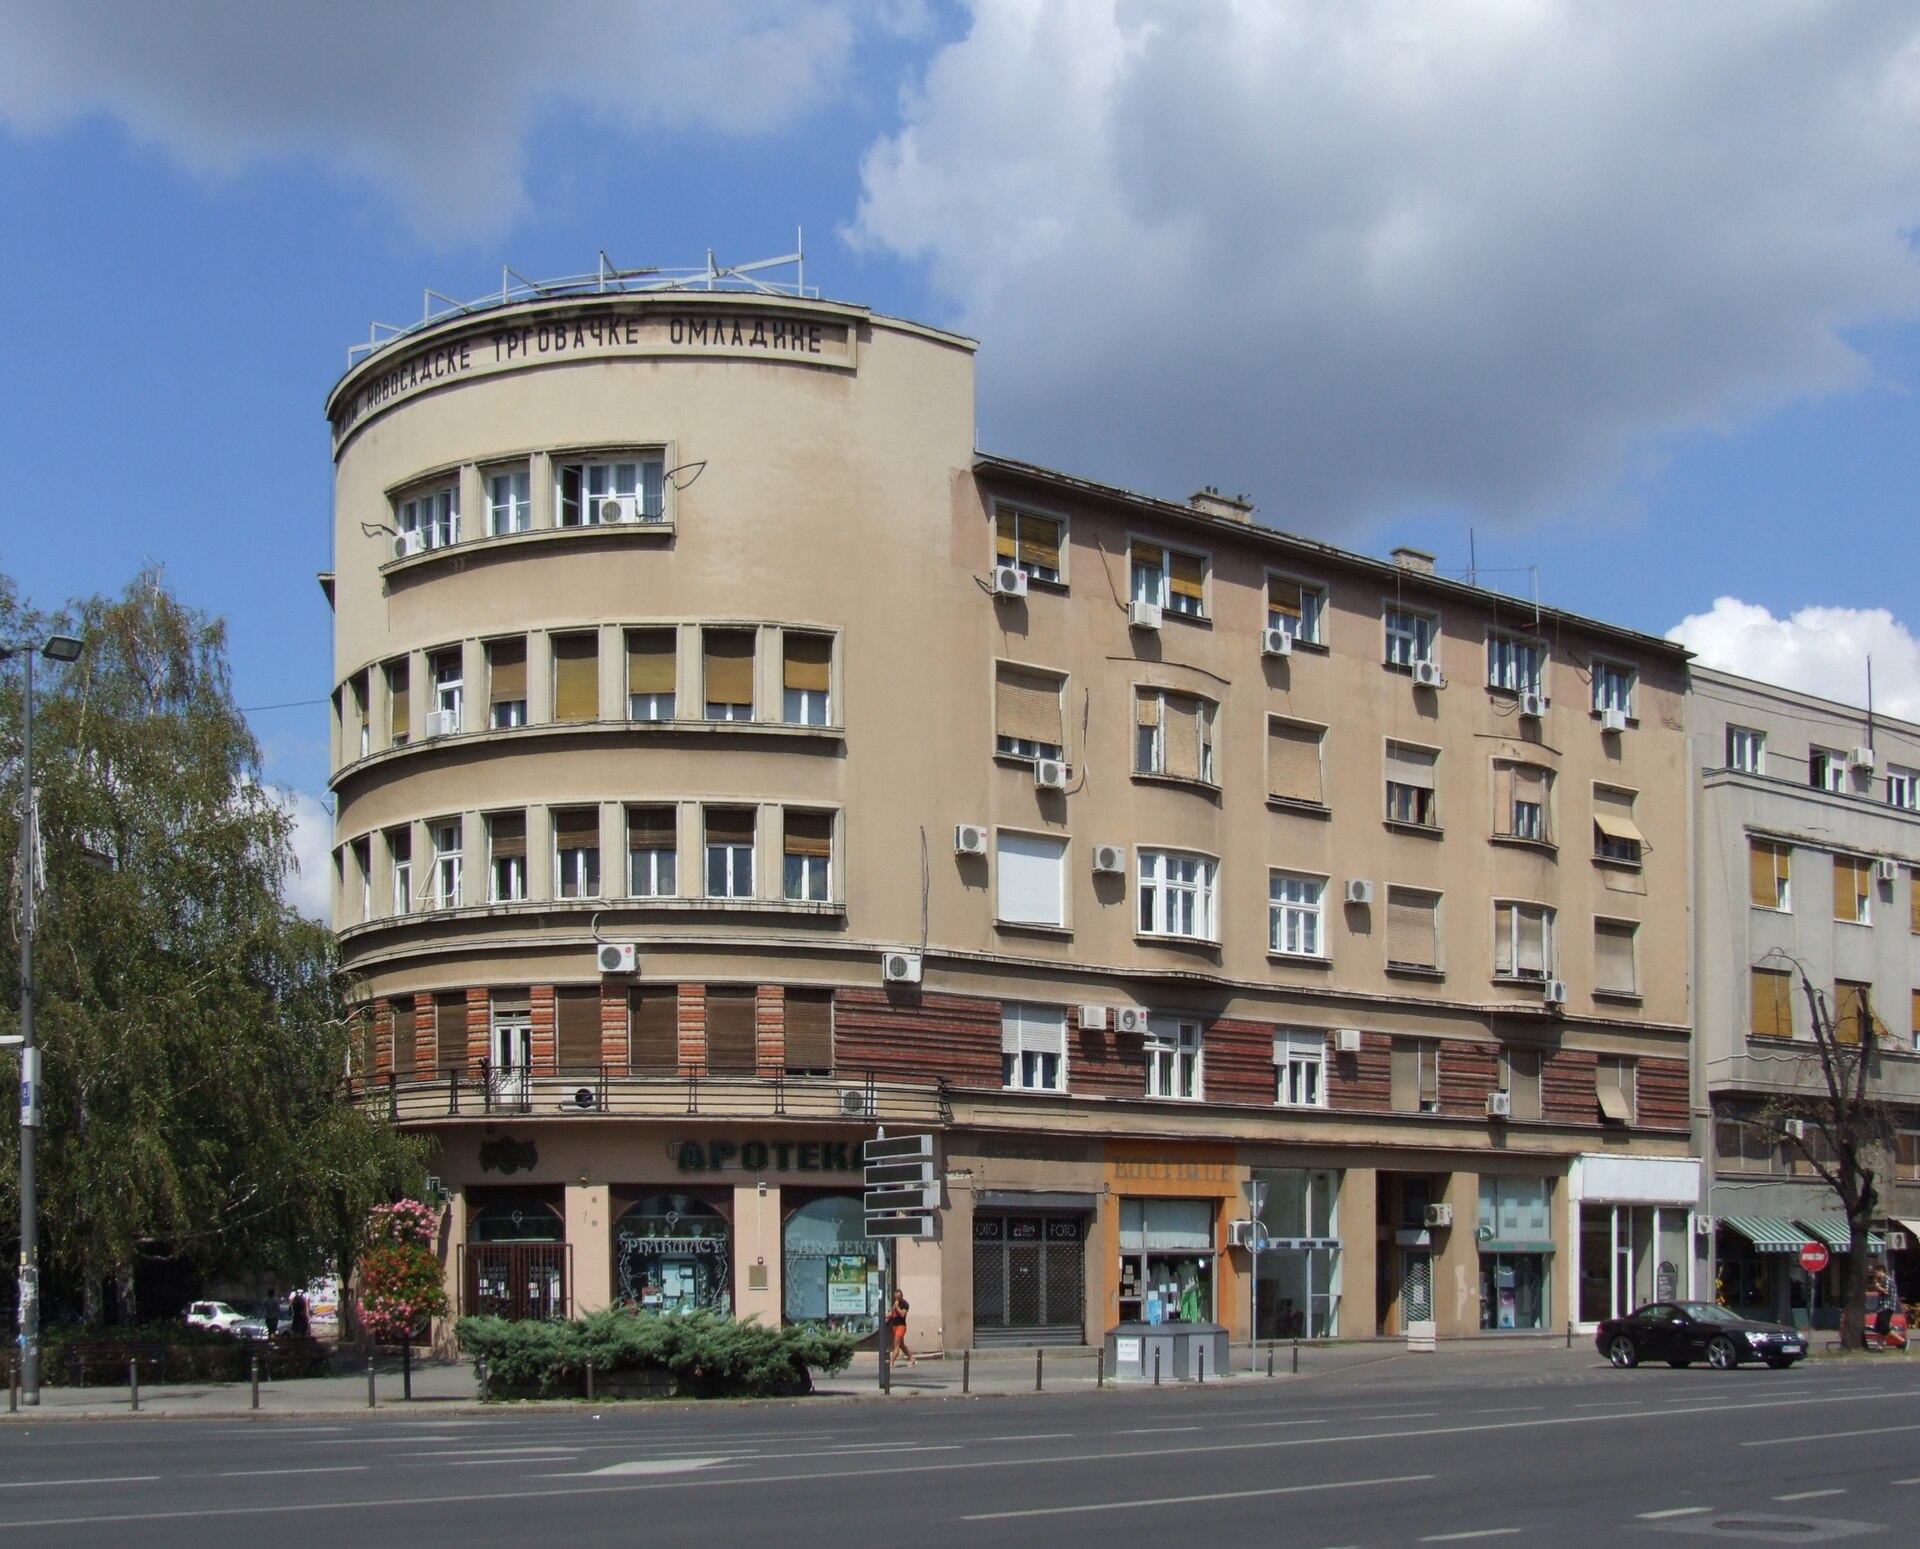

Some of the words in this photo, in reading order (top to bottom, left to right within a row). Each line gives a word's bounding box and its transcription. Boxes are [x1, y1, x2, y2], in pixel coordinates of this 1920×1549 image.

[366, 343, 470, 411] НОВОСАДСКЕ
[492, 318, 639, 361] ТРГОВАЧКЕ
[670, 318, 821, 353] ОМЛАДИНЕ
[975, 1223, 998, 1236] OTO
[1050, 1224, 1076, 1237] FOTO
